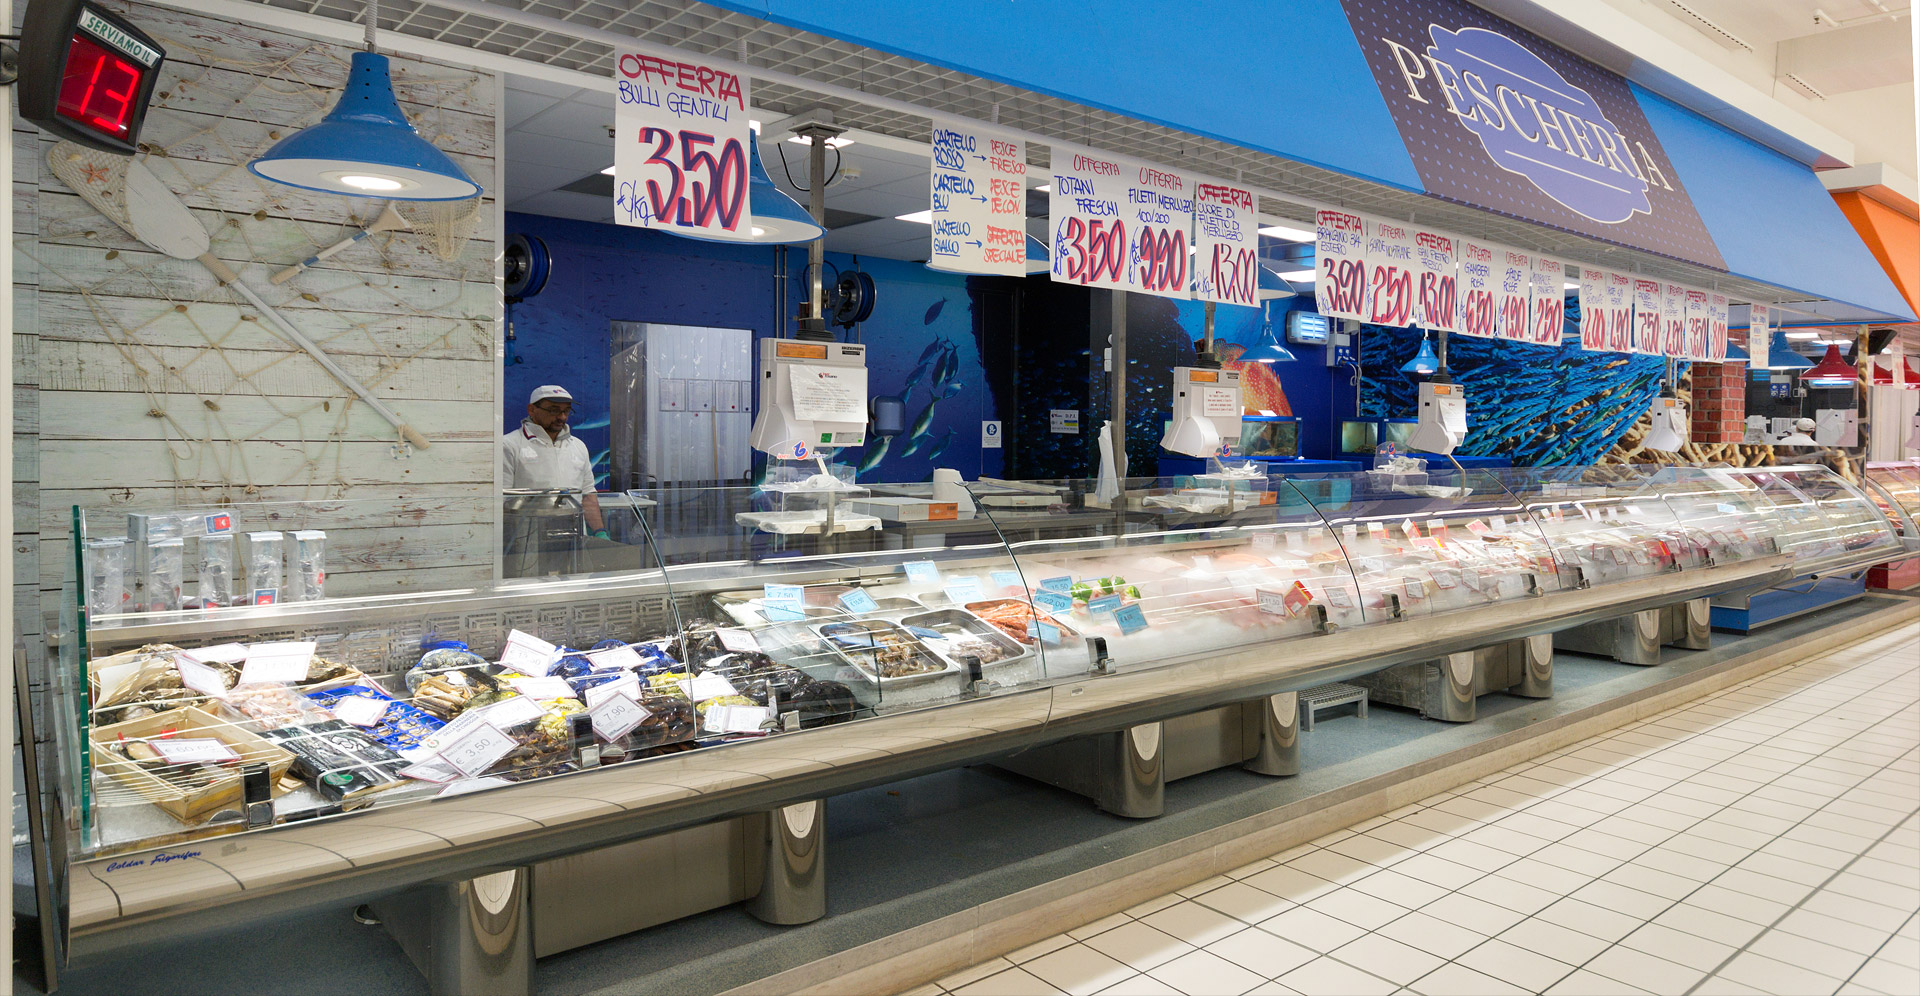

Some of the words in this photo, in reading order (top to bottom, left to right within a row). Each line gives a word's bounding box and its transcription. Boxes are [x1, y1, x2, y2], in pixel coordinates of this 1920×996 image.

[86, 17, 142, 57] SERVIAMO
[142, 47, 151, 63] IL
[619, 54, 744, 111] OFFERTA
[80, 55, 139, 132] 13
[619, 80, 660, 107] BULLI
[667, 92, 728, 122] GENTILI
[1381, 37, 1675, 192] PESCHERIA
[933, 129, 976, 153] CARTELLO
[990, 139, 1017, 157] PESCE
[933, 147, 964, 169] ROSSO
[990, 156, 1026, 175] FRESCO
[1073, 153, 1120, 176] OFFERTA
[933, 173, 974, 195] CARTELLO
[990, 178, 1020, 198] PESCE
[1054, 175, 1094, 196] TOTANI
[1139, 167, 1182, 191] OFFERTA
[933, 193, 949, 210] BLU
[1075, 198, 1119, 217] FRESCHI
[1128, 188, 1157, 204] FILETTI
[1158, 194, 1194, 214] MERLUZZO
[1198, 183, 1253, 214] OFFERTA
[1136, 208, 1170, 224] 100/200
[1197, 202, 1222, 219] CUORE
[1226, 207, 1235, 219] DI
[933, 219, 970, 236] CARTELLO
[1198, 214, 1230, 229] FILETTO
[1232, 221, 1240, 231] DI
[1316, 210, 1363, 236] OFFERTA
[1378, 223, 1407, 240] OFFERTA
[987, 225, 1025, 247] OFFERTA
[1203, 224, 1243, 242] MERLUZZO
[933, 237, 959, 254] GIALLO
[1321, 241, 1347, 256] ESTERO
[1415, 232, 1453, 258] OFFERTA
[1466, 243, 1491, 262] OFFERTA
[984, 248, 1026, 264] SPECIALE
[1505, 251, 1528, 267] OFFERTA
[1539, 258, 1560, 273] OFFERTA
[1634, 279, 1659, 298] OFFERTA
[1686, 290, 1707, 307] OFFERTA
